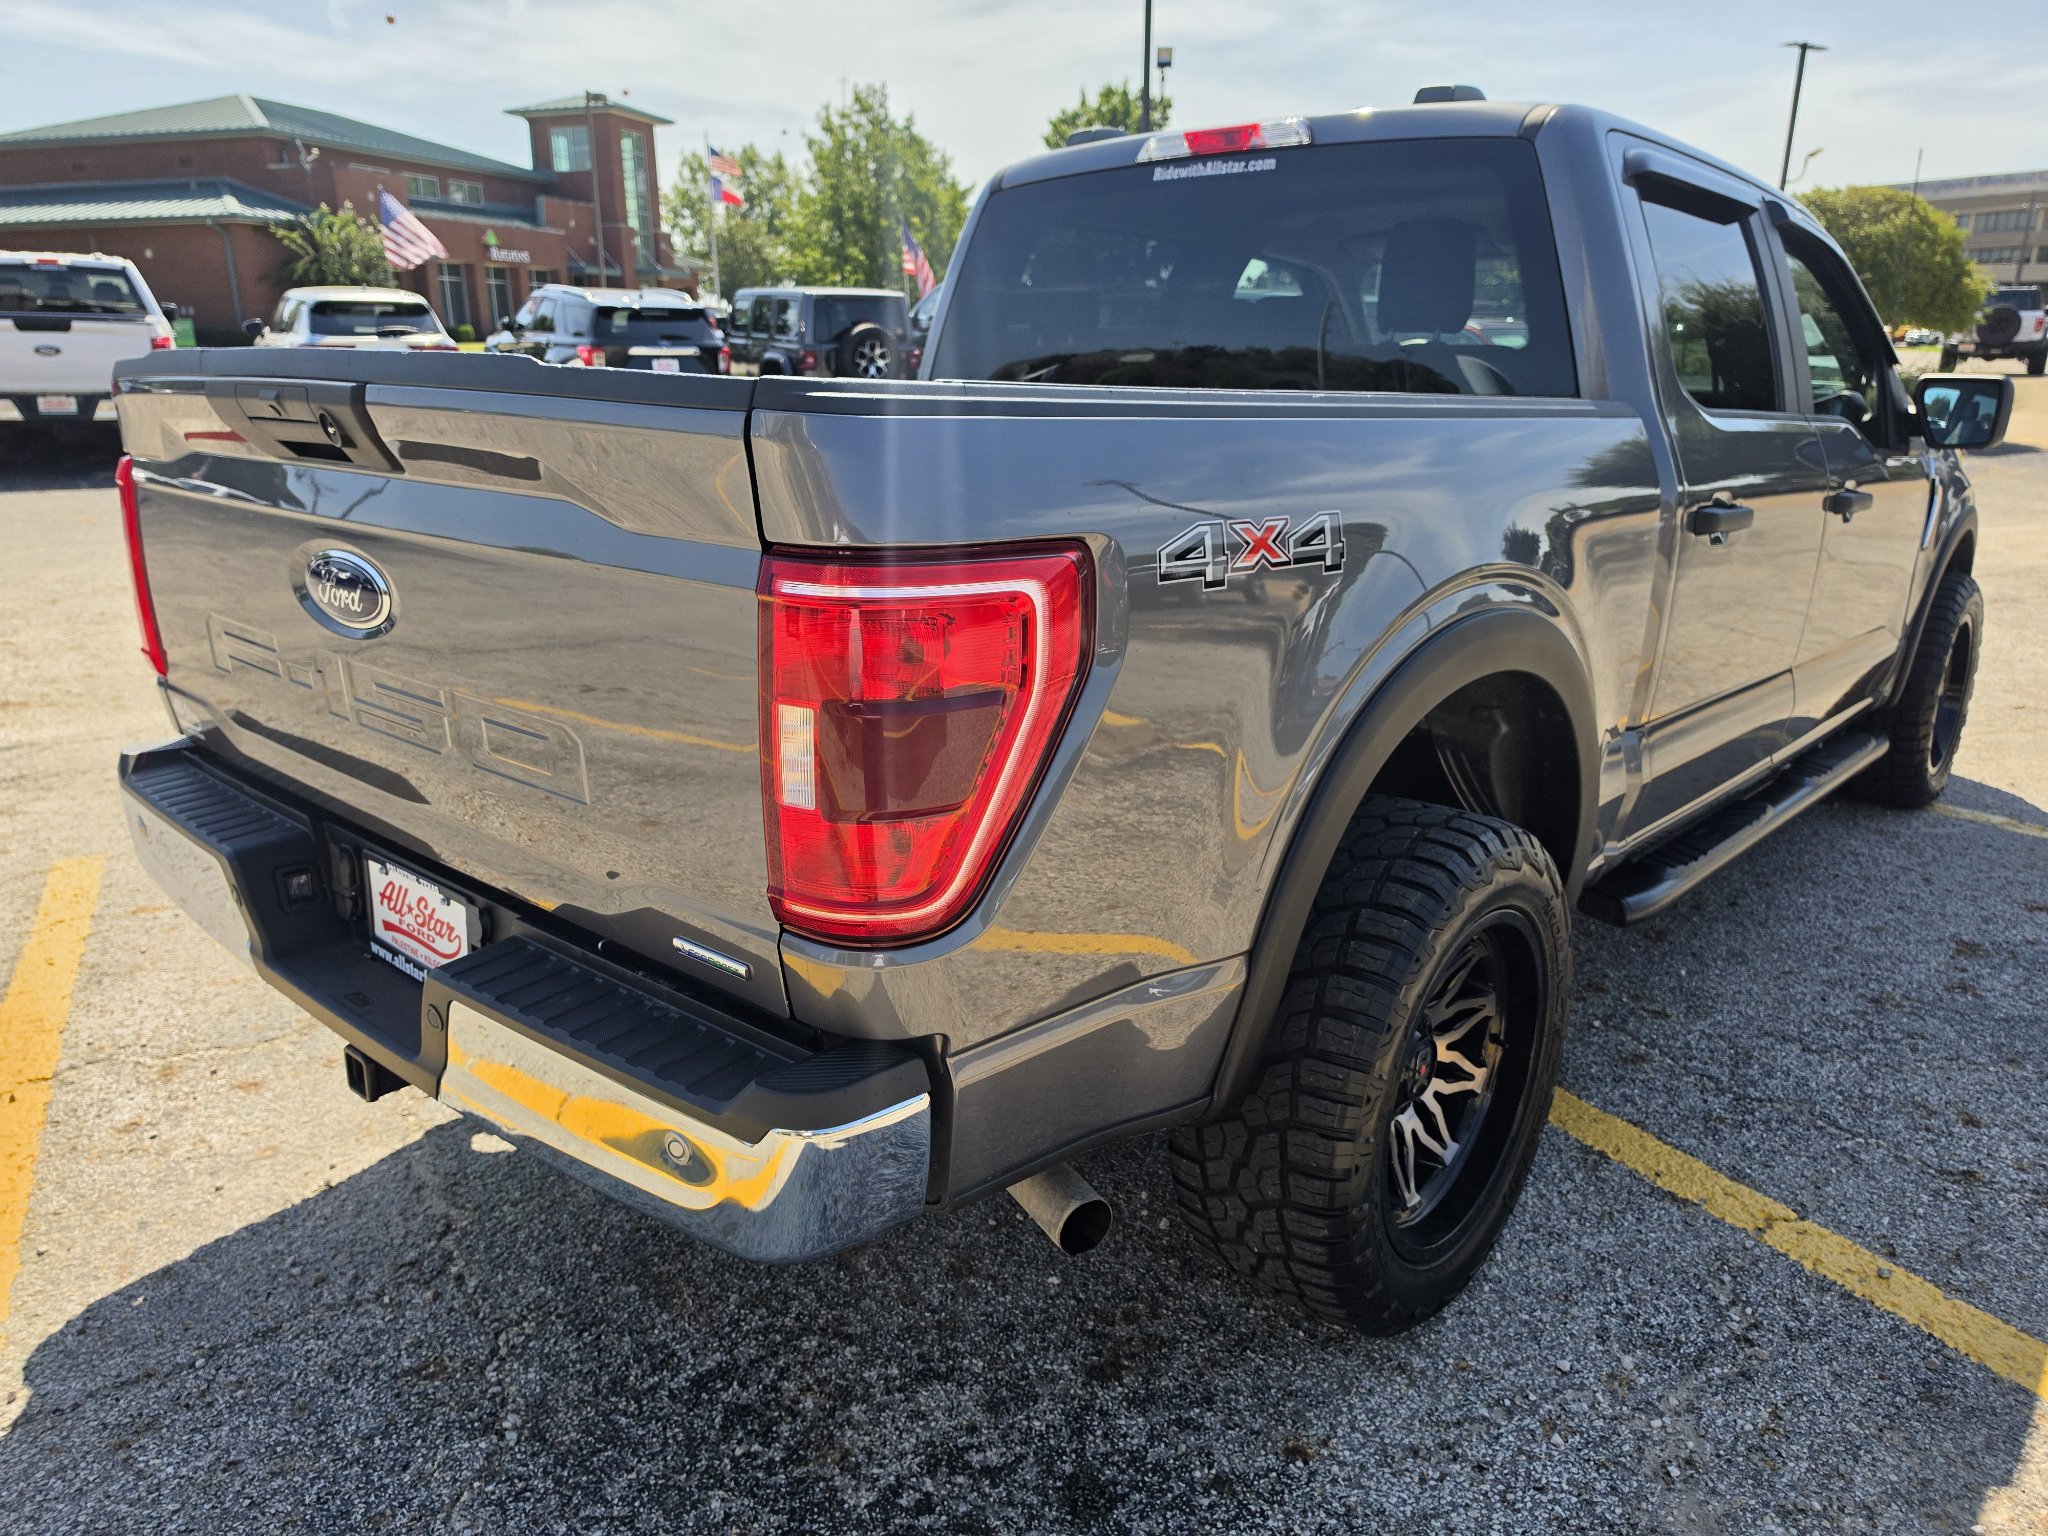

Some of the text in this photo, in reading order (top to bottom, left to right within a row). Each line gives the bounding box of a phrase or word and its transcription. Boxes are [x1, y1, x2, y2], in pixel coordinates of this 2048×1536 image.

[1153, 158, 1277, 181] RidewithAllstar.com
[318, 566, 364, 613] Ford
[206, 612, 592, 806] F-150
[398, 917, 436, 944] FORD
